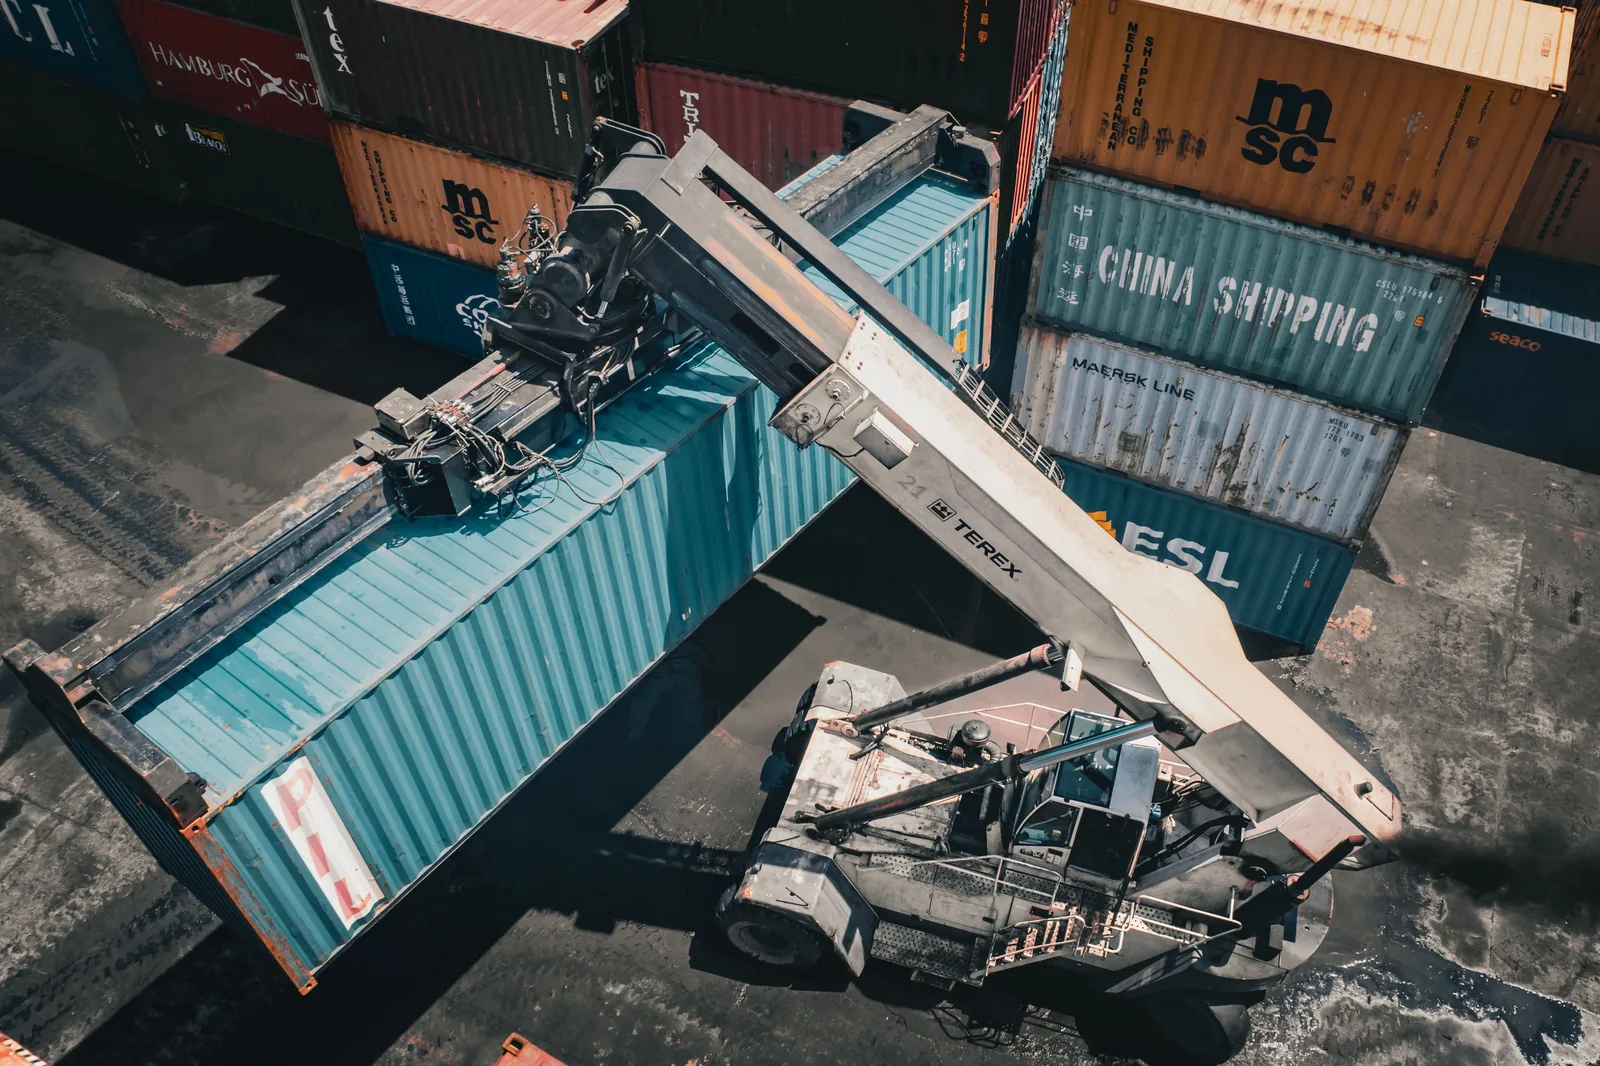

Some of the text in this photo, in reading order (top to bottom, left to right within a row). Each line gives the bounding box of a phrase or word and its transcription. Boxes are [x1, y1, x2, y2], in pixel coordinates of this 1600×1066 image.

[148, 41, 252, 88] HAMBURG
[323, 6, 356, 76] tex
[1107, 21, 1139, 151] MEDITERRANEAN
[1127, 36, 1154, 145] SHIPPING CO
[679, 89, 700, 143] TRI
[373, 150, 393, 204] SHIPPING
[1098, 245, 1379, 352] CHINA SHIPPING
[1375, 279, 1398, 291] CSLU
[1488, 331, 1542, 352] seaco
[1072, 357, 1195, 402] MAERSK LINE
[1329, 418, 1349, 429] MSKU
[897, 475, 927, 500] 21
[954, 518, 1023, 579] TEREX
[1122, 521, 1240, 589] ESL
[275, 767, 373, 921] PIL
